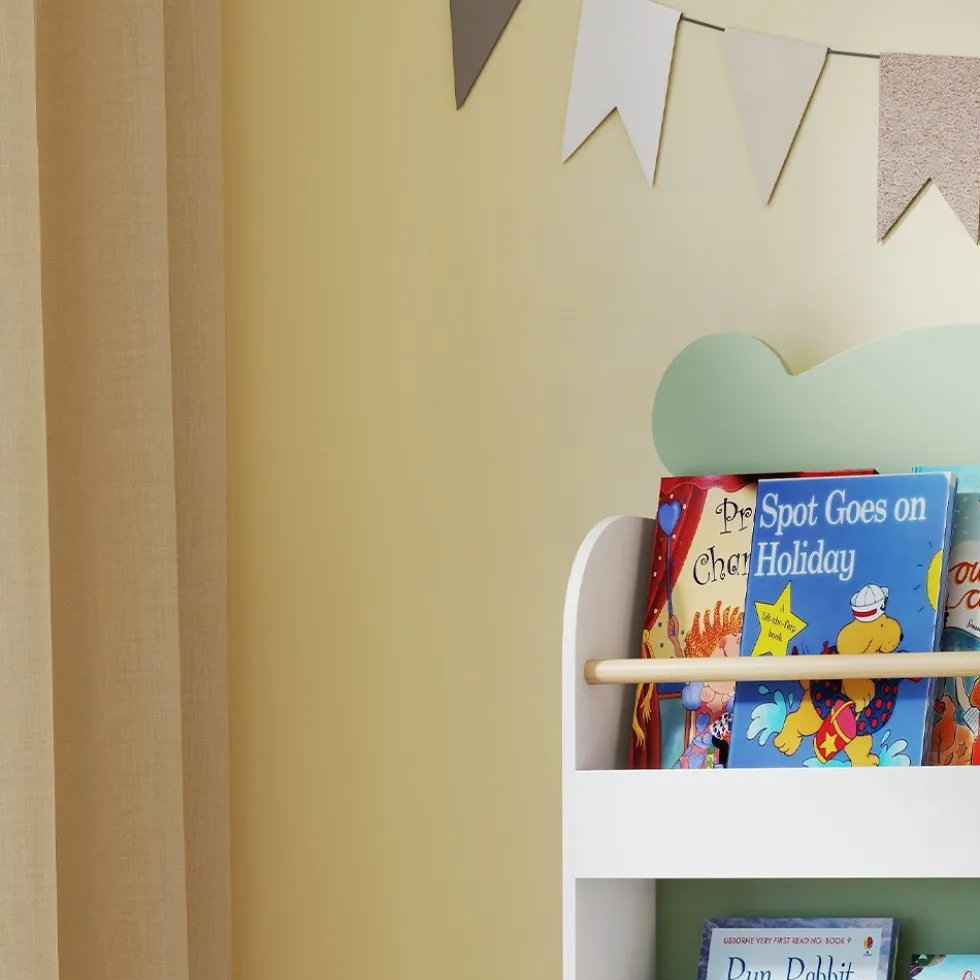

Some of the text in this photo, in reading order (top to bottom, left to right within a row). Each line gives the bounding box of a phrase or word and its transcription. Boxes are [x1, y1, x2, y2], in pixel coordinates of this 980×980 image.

[759, 488, 927, 536] Spot Goes on
[754, 539, 856, 582] Holiday
[723, 936, 754, 945] USBORNE
[756, 936, 773, 945] VERY
[773, 936, 790, 945] FIRST
[825, 936, 845, 945] BOOK
